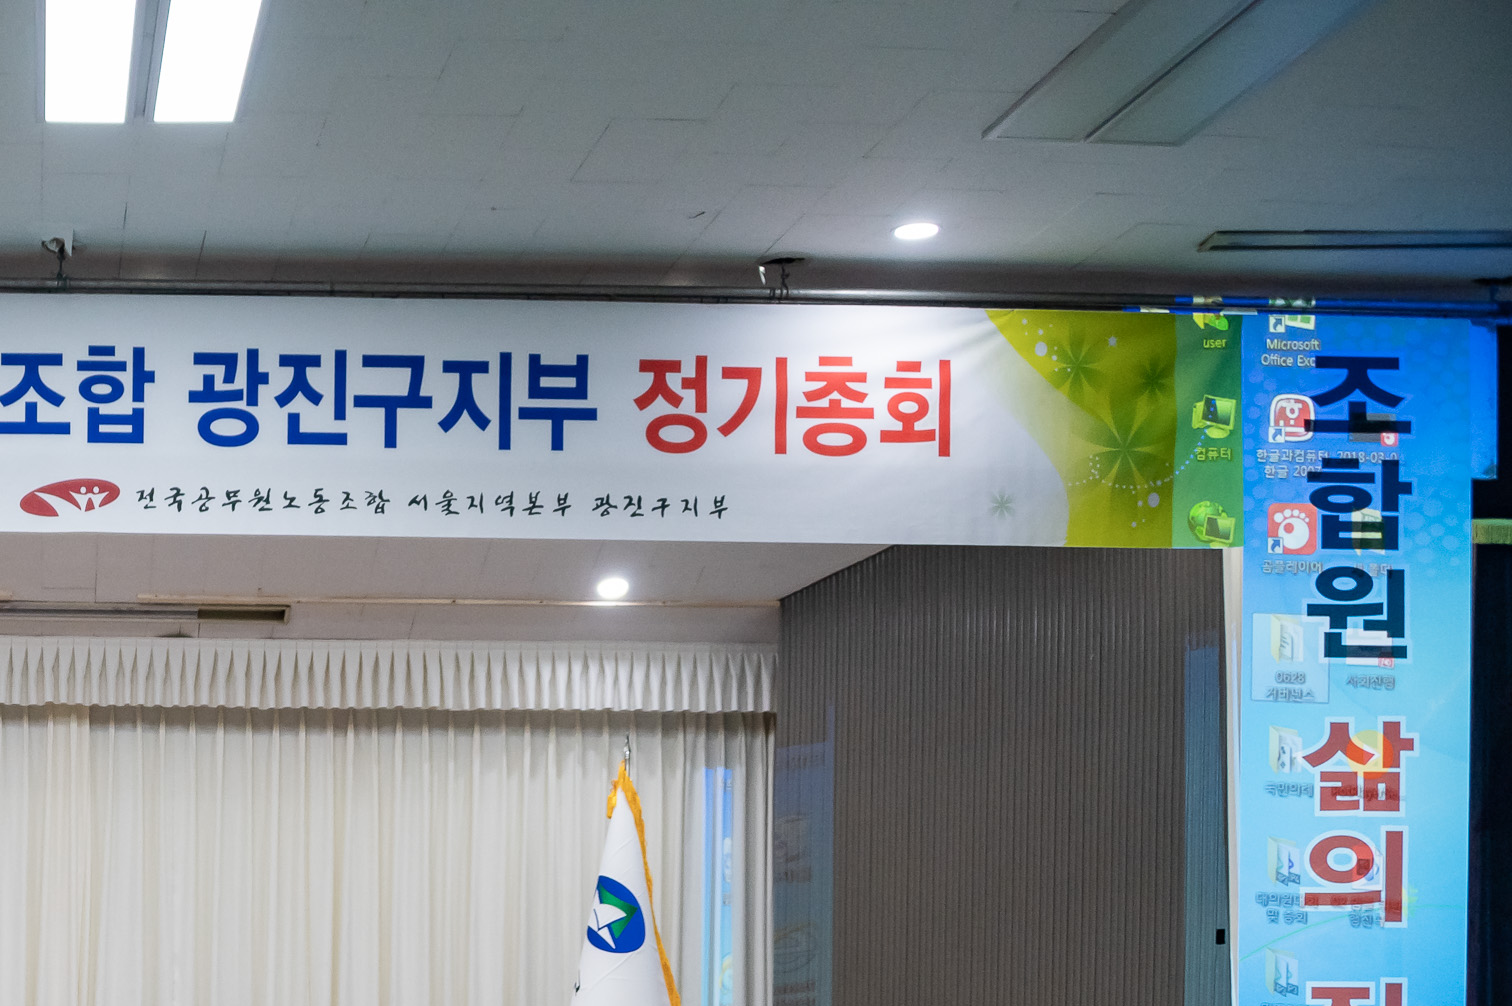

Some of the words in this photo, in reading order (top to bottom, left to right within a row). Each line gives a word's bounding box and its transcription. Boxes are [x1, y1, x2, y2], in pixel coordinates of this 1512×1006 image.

[1203, 339, 1227, 349] user
[1266, 338, 1320, 350] Microsoft
[1261, 354, 1294, 367] Office
[1297, 355, 1316, 367] Exc
[188, 347, 598, 452] 광진구지부
[633, 355, 952, 458] 정기총회
[1264, 464, 1289, 479] 한글
[136, 485, 391, 514] 전국공무원노동조합
[408, 488, 573, 517] 서울지역본부
[591, 494, 729, 519] 광진구지부
[1303, 356, 1412, 660] 조합원
[1301, 721, 1414, 923] 삶의
